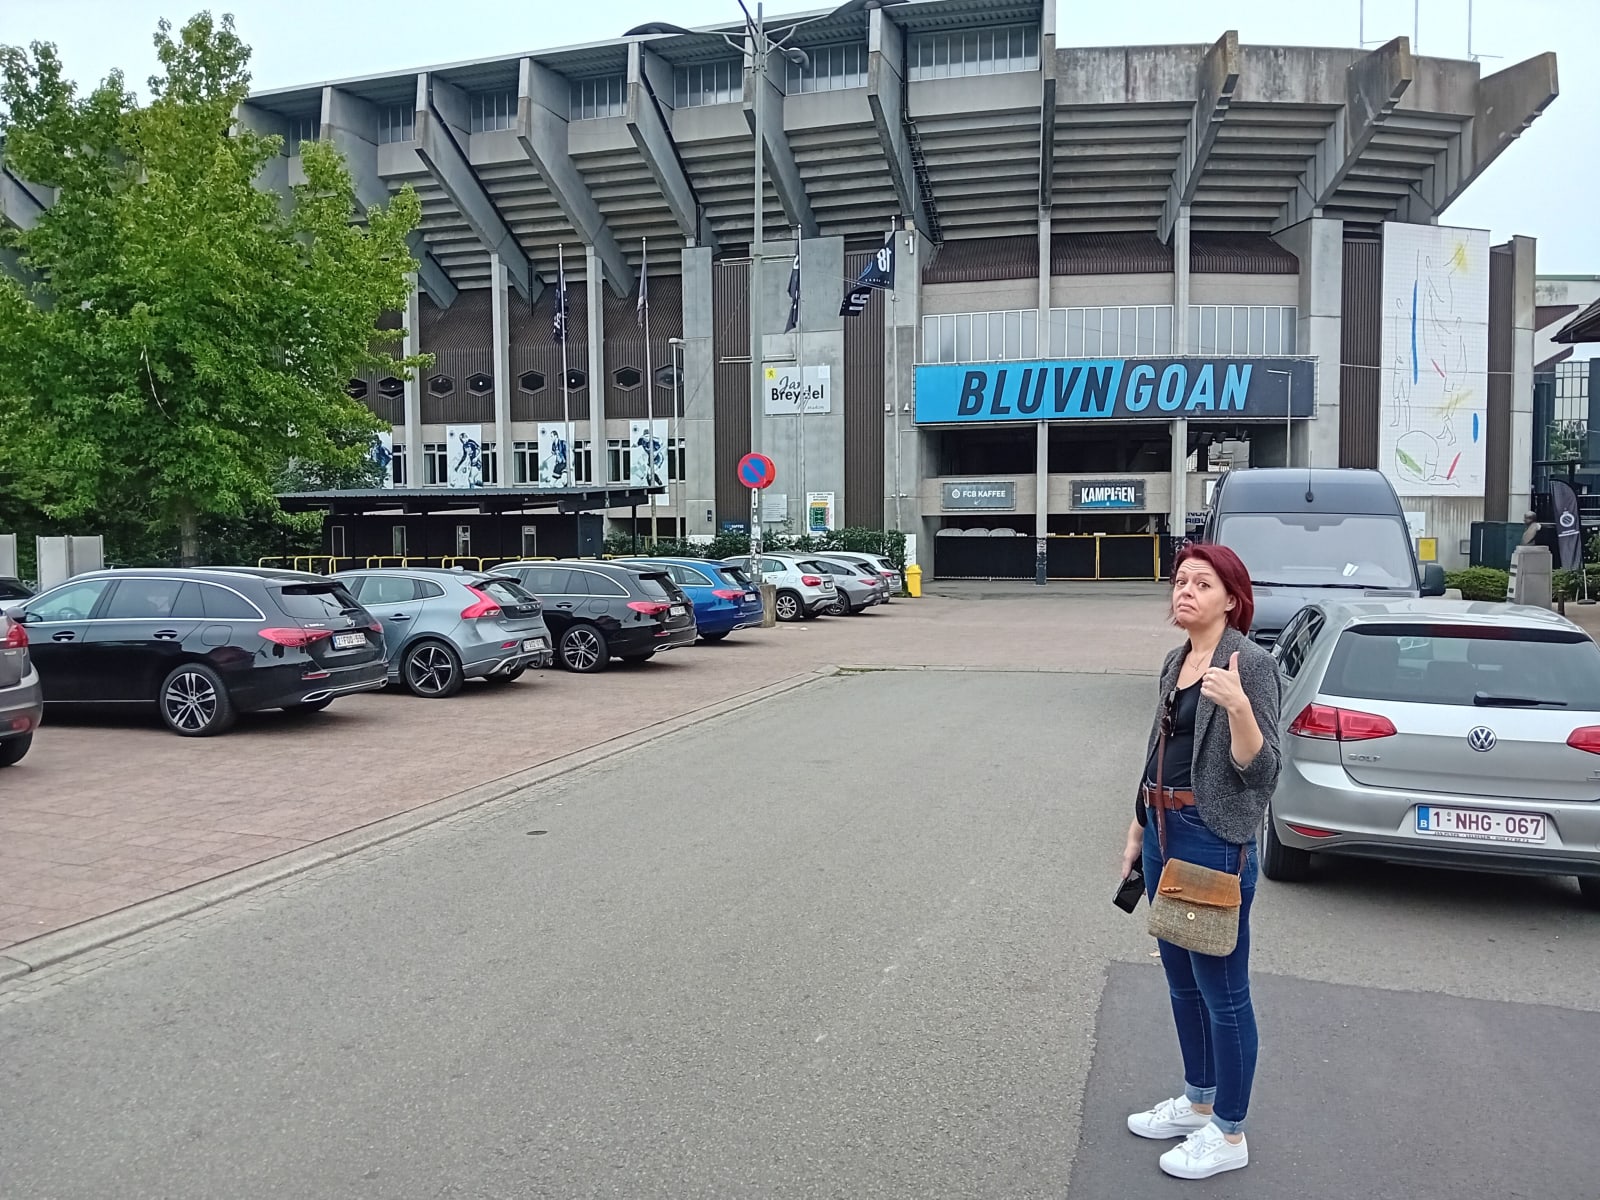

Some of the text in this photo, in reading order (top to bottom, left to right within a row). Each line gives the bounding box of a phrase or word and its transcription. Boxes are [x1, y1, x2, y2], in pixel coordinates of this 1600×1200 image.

[957, 363, 1253, 416] BLUVN GOAN
[962, 490, 1006, 498] FCB KAFFEE
